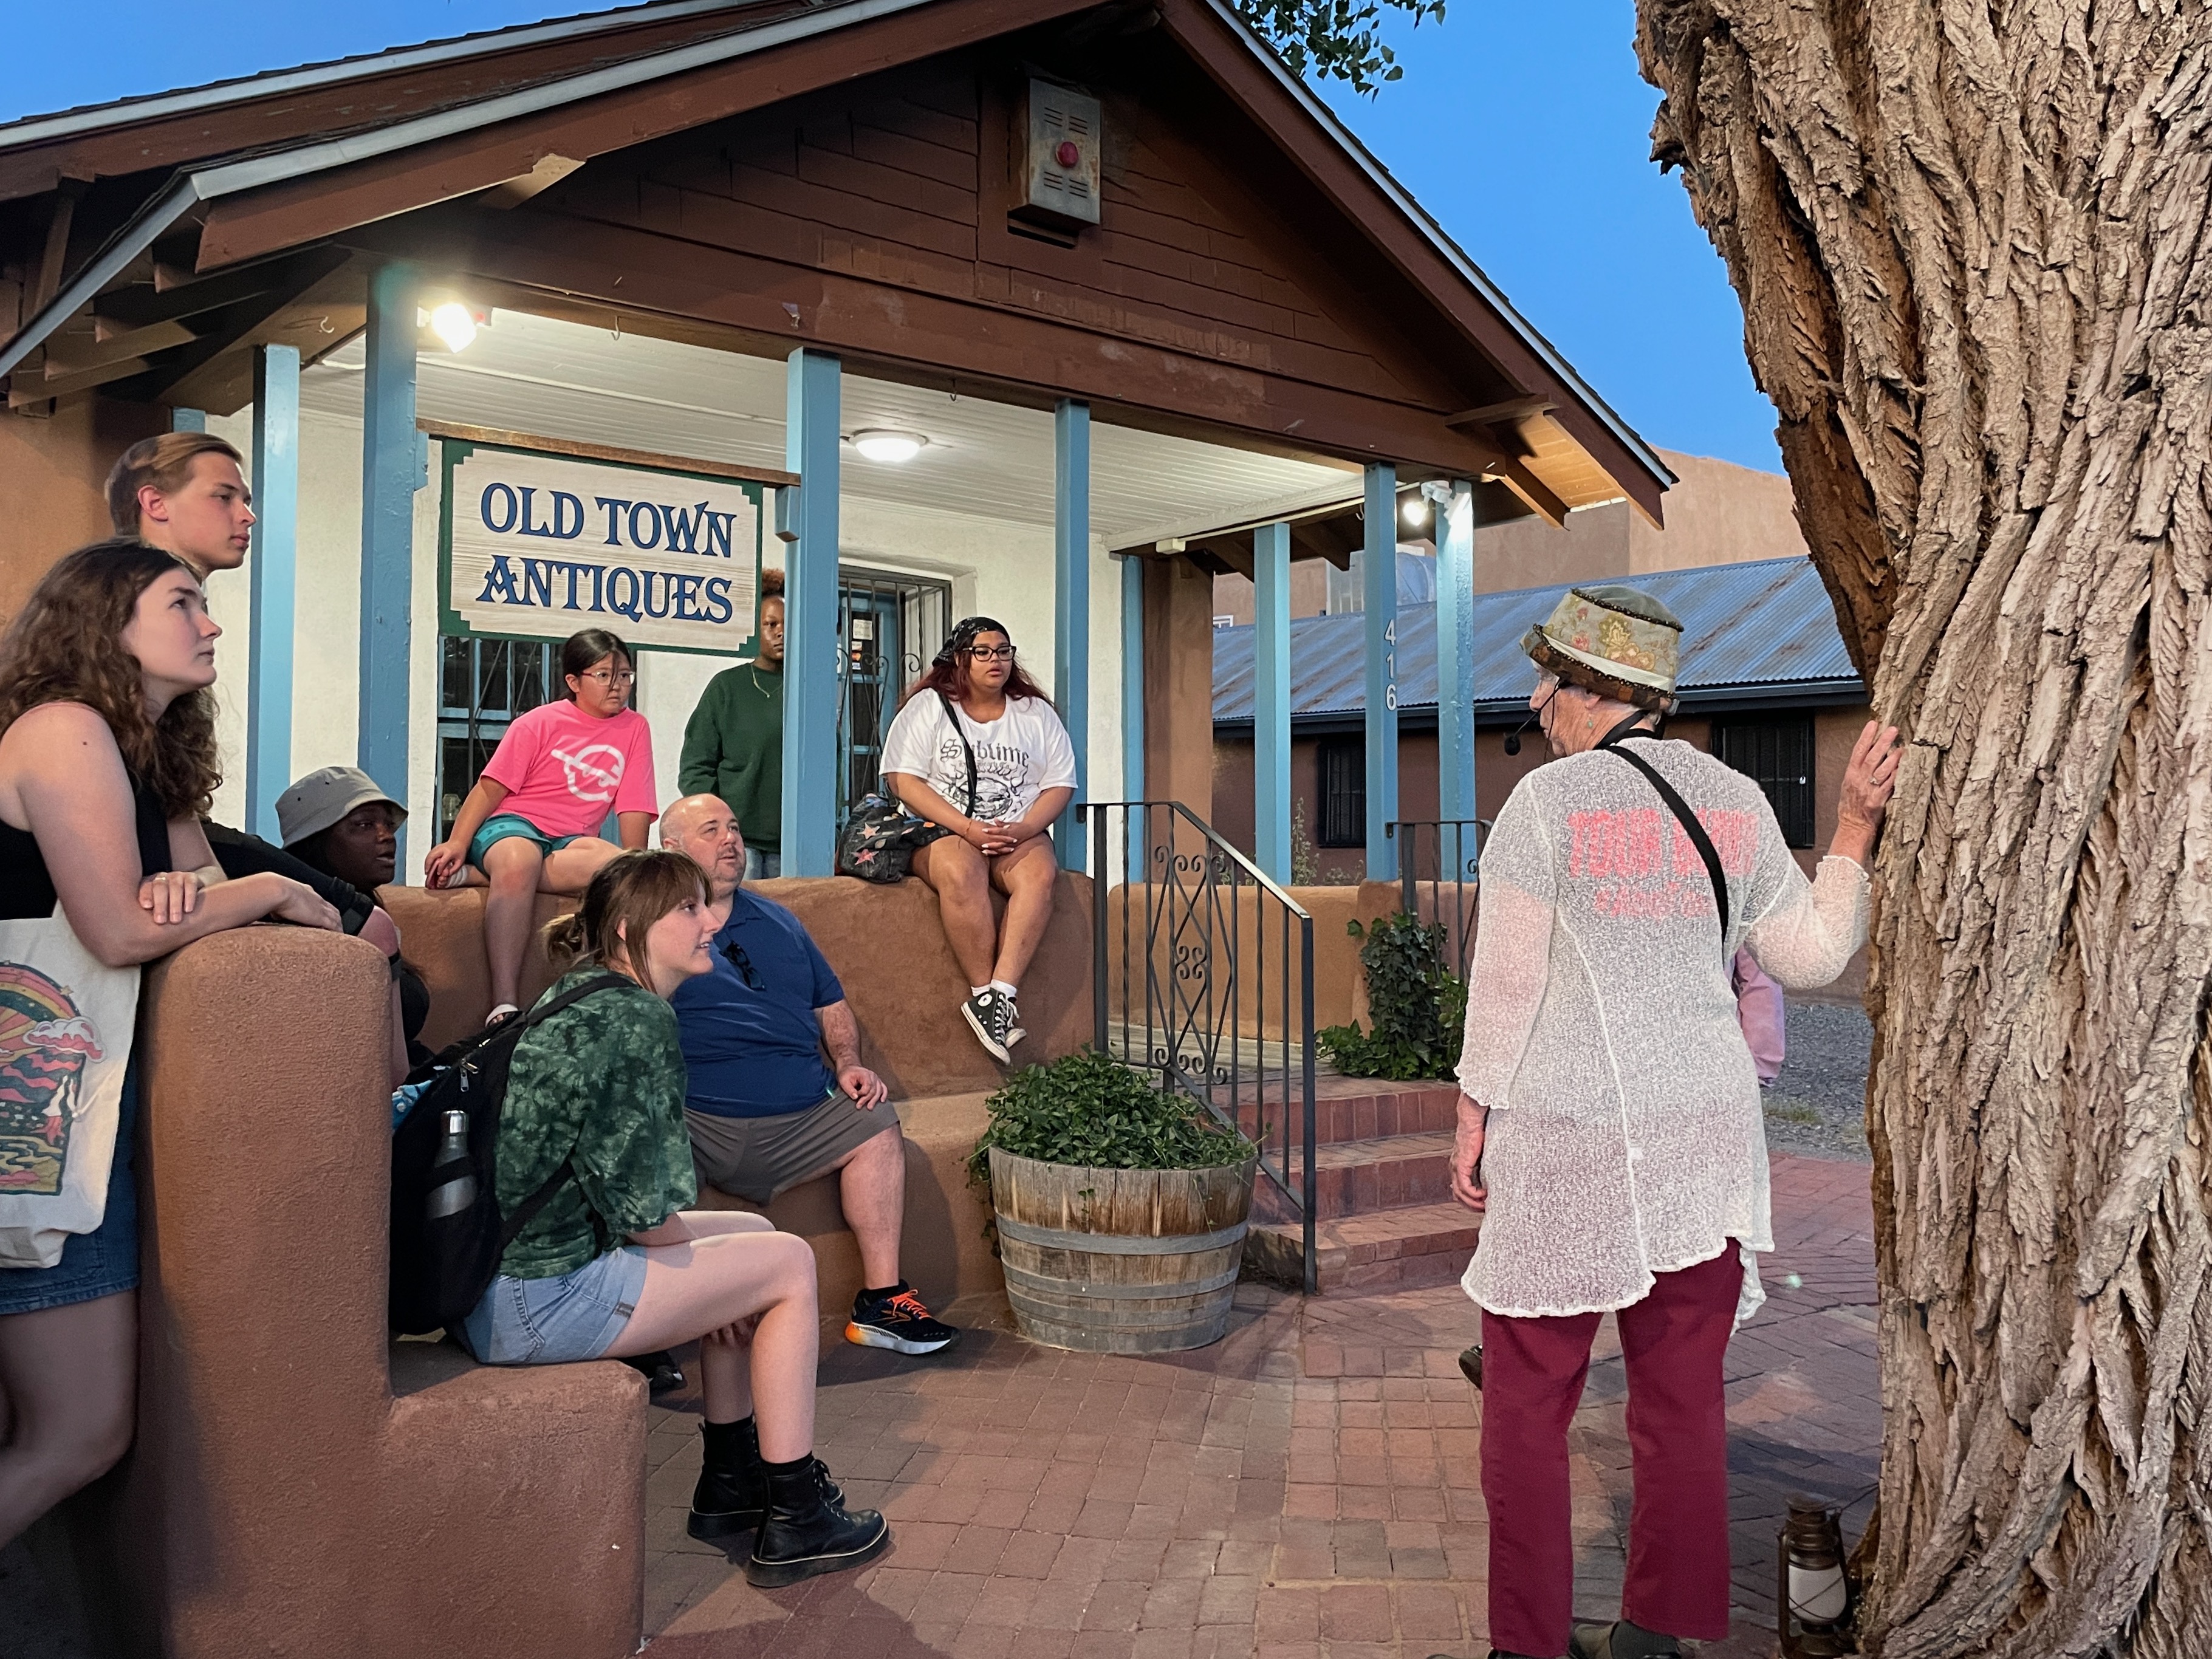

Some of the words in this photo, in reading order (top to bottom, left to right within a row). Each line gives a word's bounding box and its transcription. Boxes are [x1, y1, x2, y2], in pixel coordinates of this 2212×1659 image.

[481, 482, 584, 539] OLD
[594, 496, 738, 558] TOWN
[475, 554, 733, 624] ANTIQUES
[1384, 618, 1397, 711] 416
